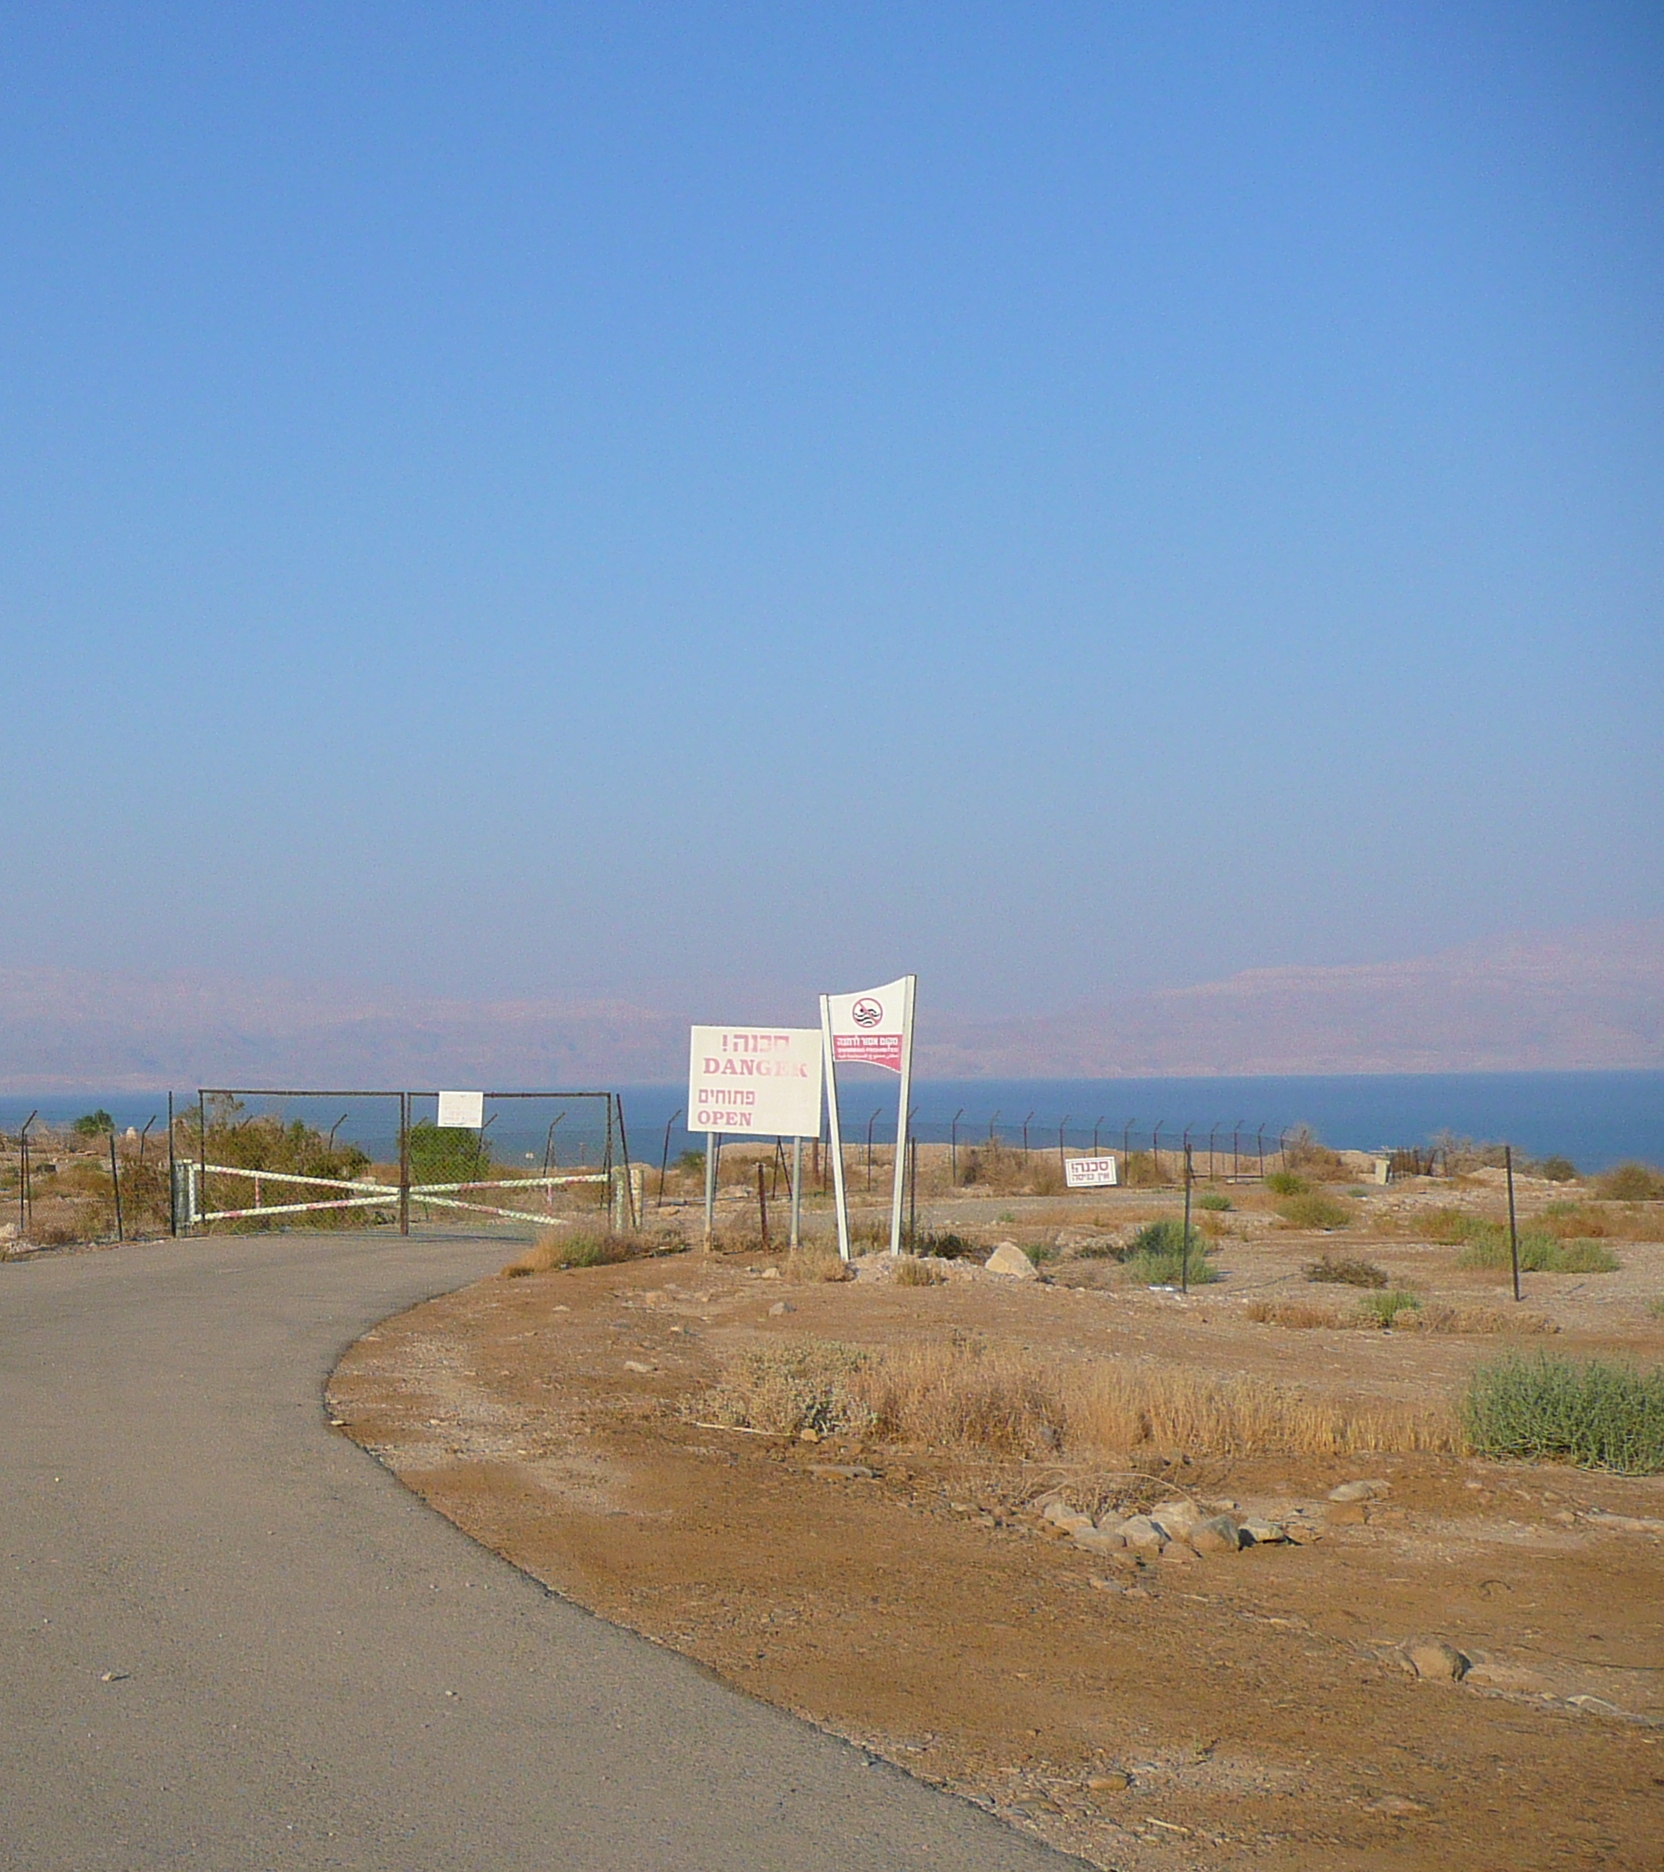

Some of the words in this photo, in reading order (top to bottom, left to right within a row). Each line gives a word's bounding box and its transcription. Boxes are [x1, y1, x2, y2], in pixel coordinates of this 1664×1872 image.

[698, 1089, 755, 1105] פתוחים
[697, 1110, 752, 1126] OPEN
[1071, 1161, 1109, 1173] סכנה!
